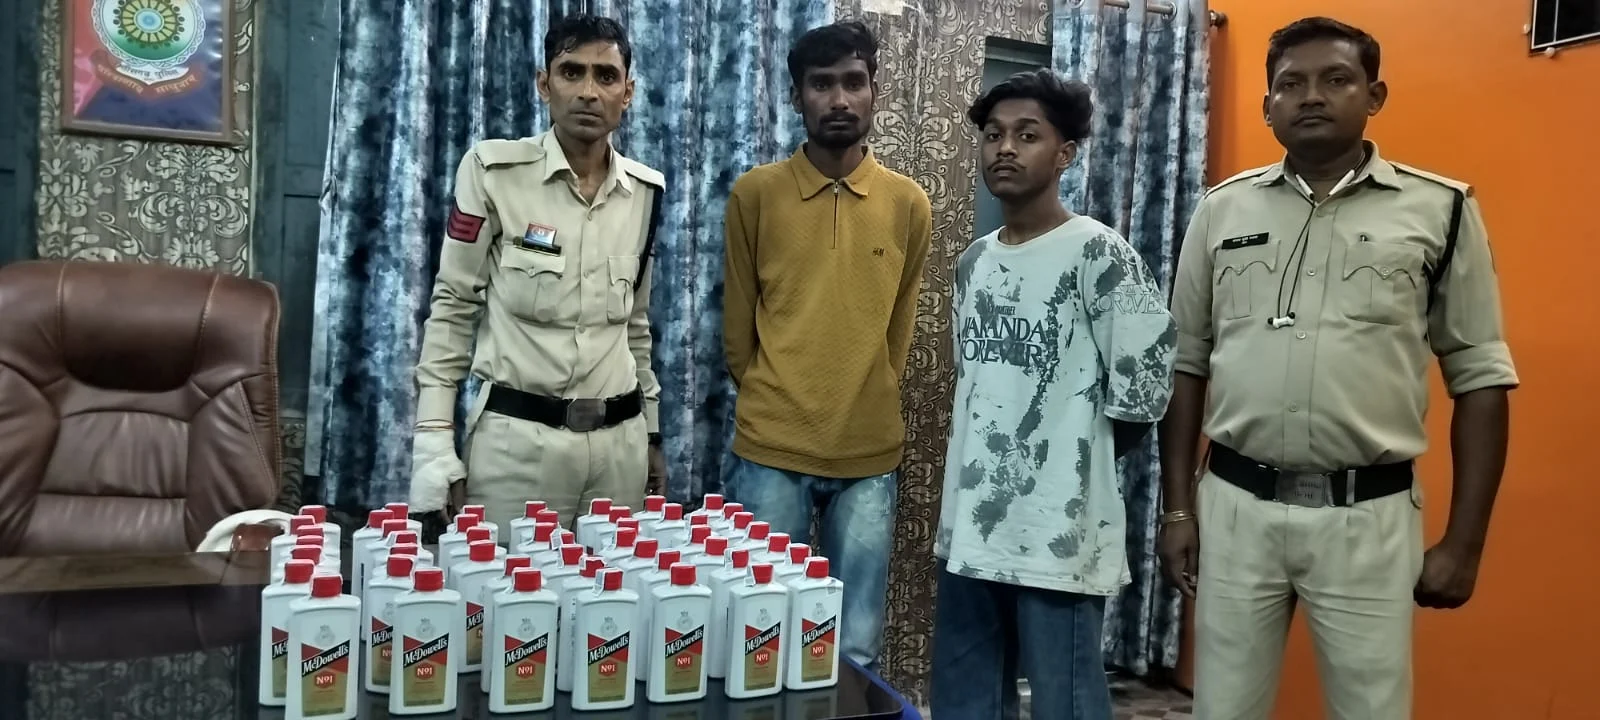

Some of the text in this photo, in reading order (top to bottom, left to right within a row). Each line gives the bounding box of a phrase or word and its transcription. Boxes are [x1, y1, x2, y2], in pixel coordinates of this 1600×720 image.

[665, 629, 703, 657] McDowell's
[745, 624, 780, 655] McDowell's
[802, 619, 836, 647] McDowell's
[303, 644, 349, 675] McDowell's
[404, 638, 448, 667] McDowell's
[505, 637, 547, 666] McDowell's
[588, 635, 629, 664] McDowell's
